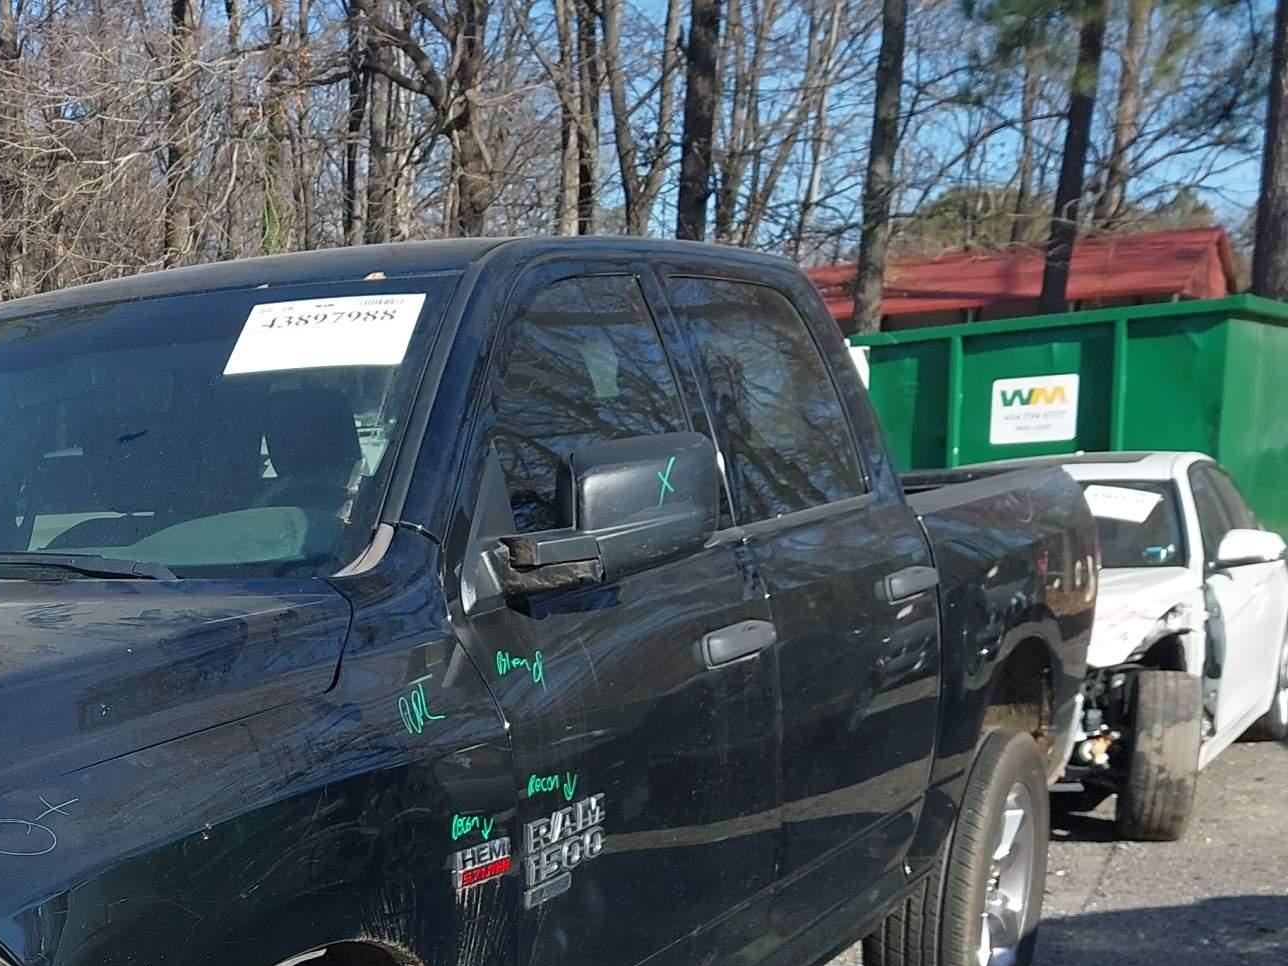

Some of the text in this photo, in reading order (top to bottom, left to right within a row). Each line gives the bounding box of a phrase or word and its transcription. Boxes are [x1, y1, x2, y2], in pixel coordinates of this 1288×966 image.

[262, 309, 398, 329] 43897988
[999, 384, 1067, 407] WM
[524, 793, 606, 853] RAM
[524, 826, 606, 888] 1500
